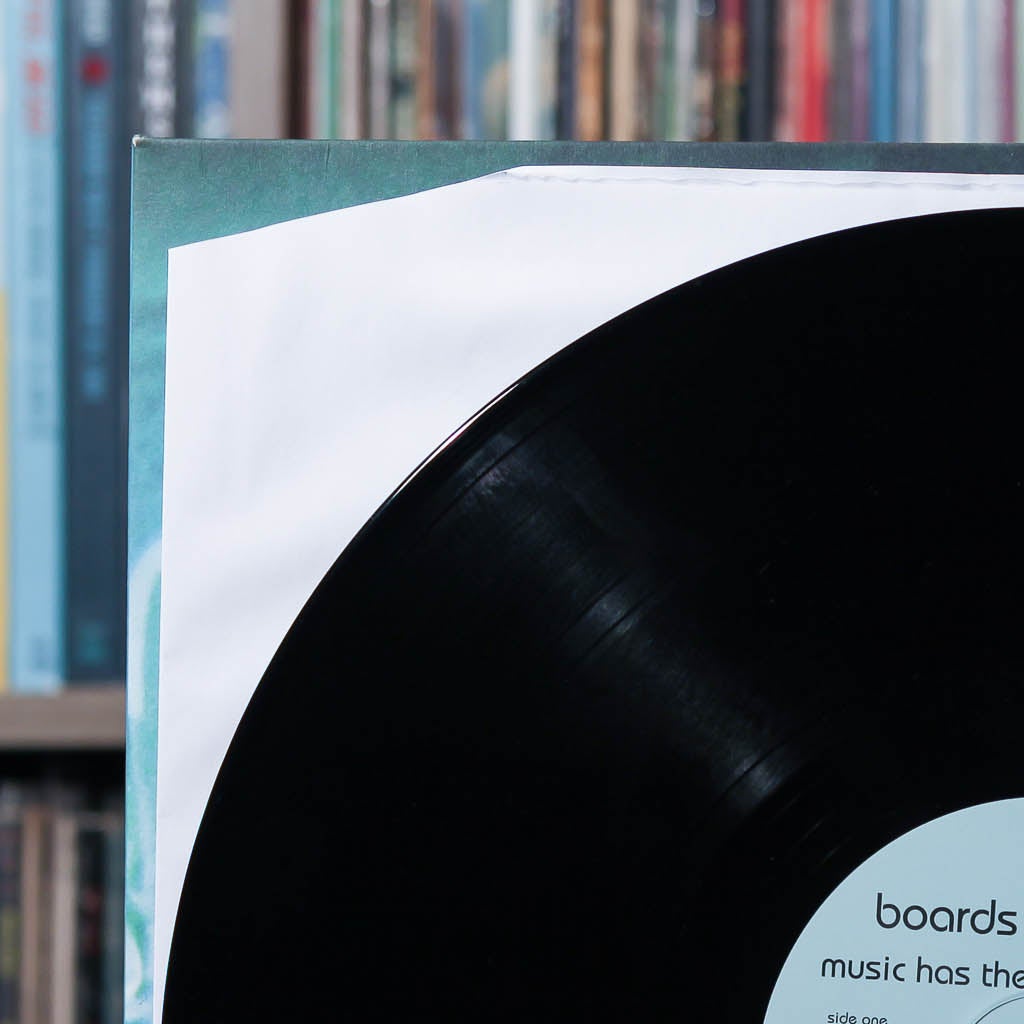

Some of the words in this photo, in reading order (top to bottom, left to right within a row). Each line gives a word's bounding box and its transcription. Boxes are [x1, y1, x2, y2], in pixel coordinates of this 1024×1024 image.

[875, 892, 1018, 936] boards
[821, 956, 906, 983] music
[915, 956, 971, 986] has
[827, 1012, 857, 1024] side
